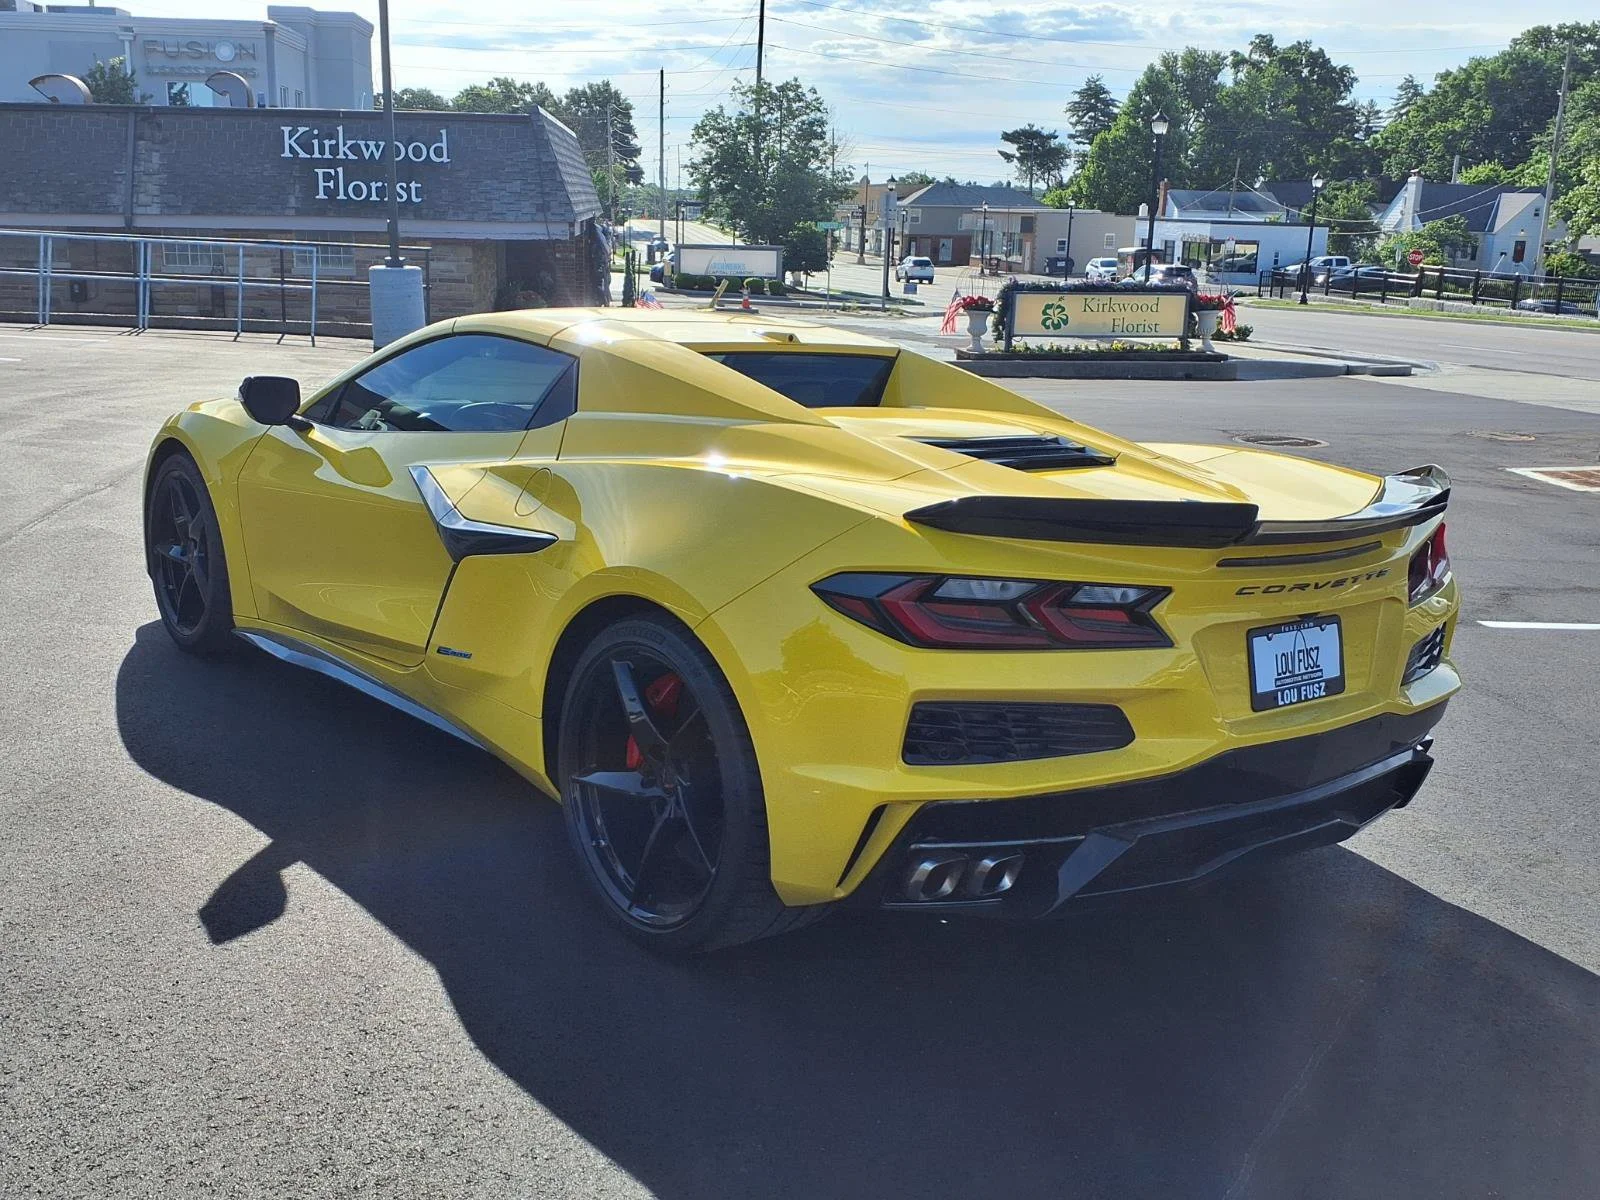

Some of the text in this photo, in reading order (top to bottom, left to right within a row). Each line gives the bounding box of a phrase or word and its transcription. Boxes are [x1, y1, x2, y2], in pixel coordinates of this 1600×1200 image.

[143, 40, 257, 61] FUSION
[280, 125, 452, 163] Kirkwood
[1409, 253, 1423, 261] STOP
[1082, 297, 1160, 313] Kirkwood
[1111, 317, 1160, 333] Florist
[1235, 567, 1391, 595] CORVETTE
[1275, 646, 1320, 676] LOU FUSZ
[1278, 682, 1325, 705] LOU FUSZ
